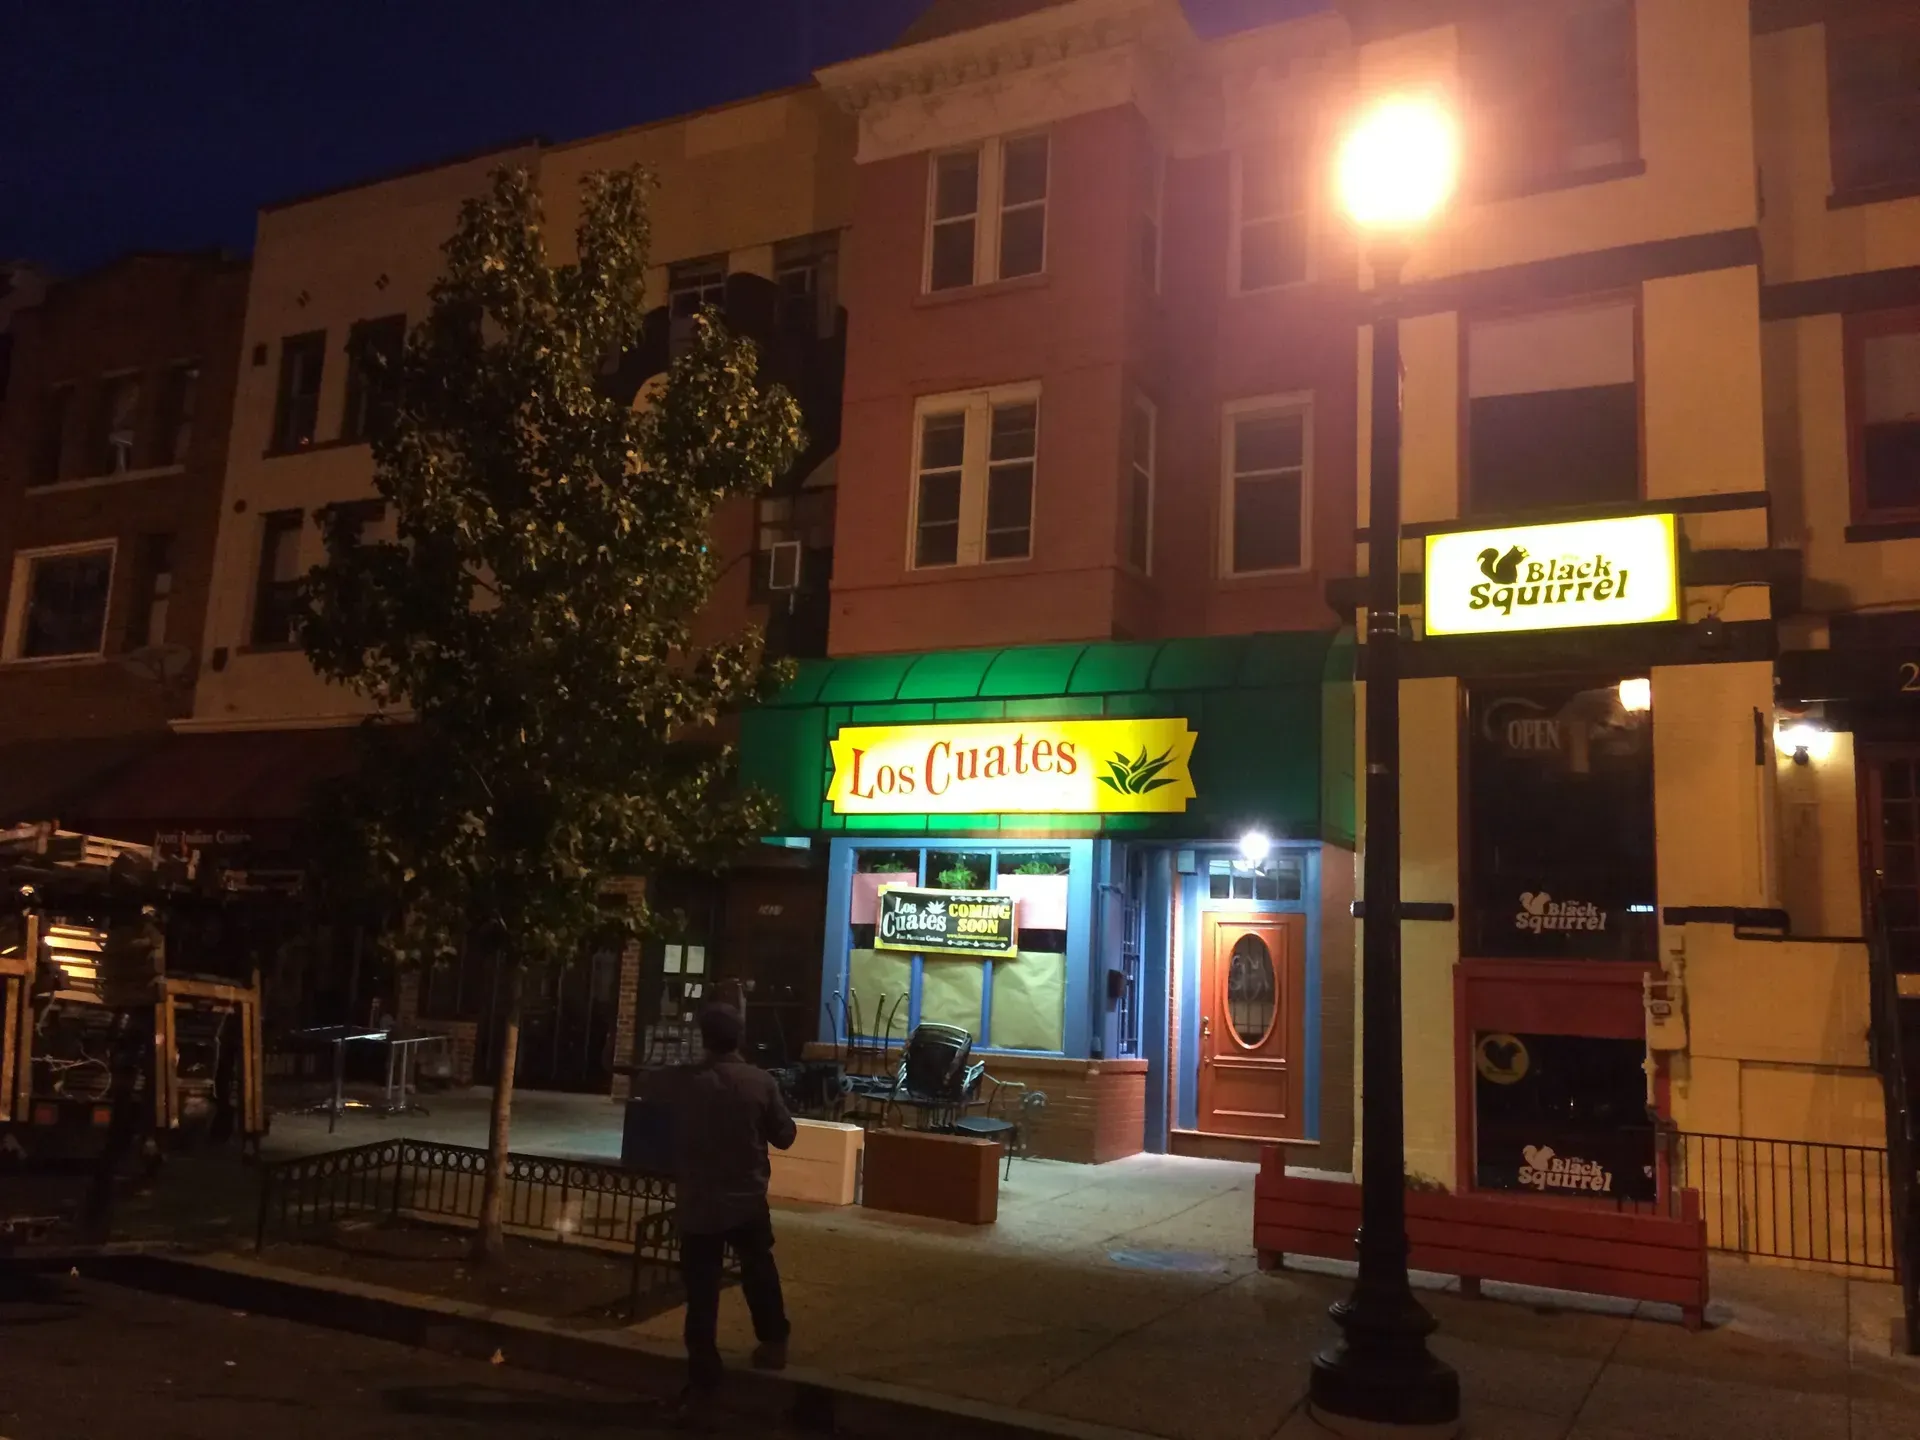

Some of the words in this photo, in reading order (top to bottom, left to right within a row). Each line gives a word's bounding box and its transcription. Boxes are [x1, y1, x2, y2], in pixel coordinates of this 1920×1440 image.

[1525, 555, 1612, 583] Black
[1469, 570, 1628, 616] Squirrel
[1507, 719, 1561, 750] OPEN
[850, 748, 915, 799] Los
[925, 733, 1078, 796] Cuates
[895, 896, 917, 914] Los
[948, 903, 1011, 920] COMING
[1549, 902, 1598, 917] Black
[882, 909, 947, 937] Cuates
[957, 918, 999, 933] SOON
[1515, 911, 1607, 934] Squirrel
[1518, 1166, 1612, 1191] Squirrel
[1551, 1158, 1603, 1176] Black
